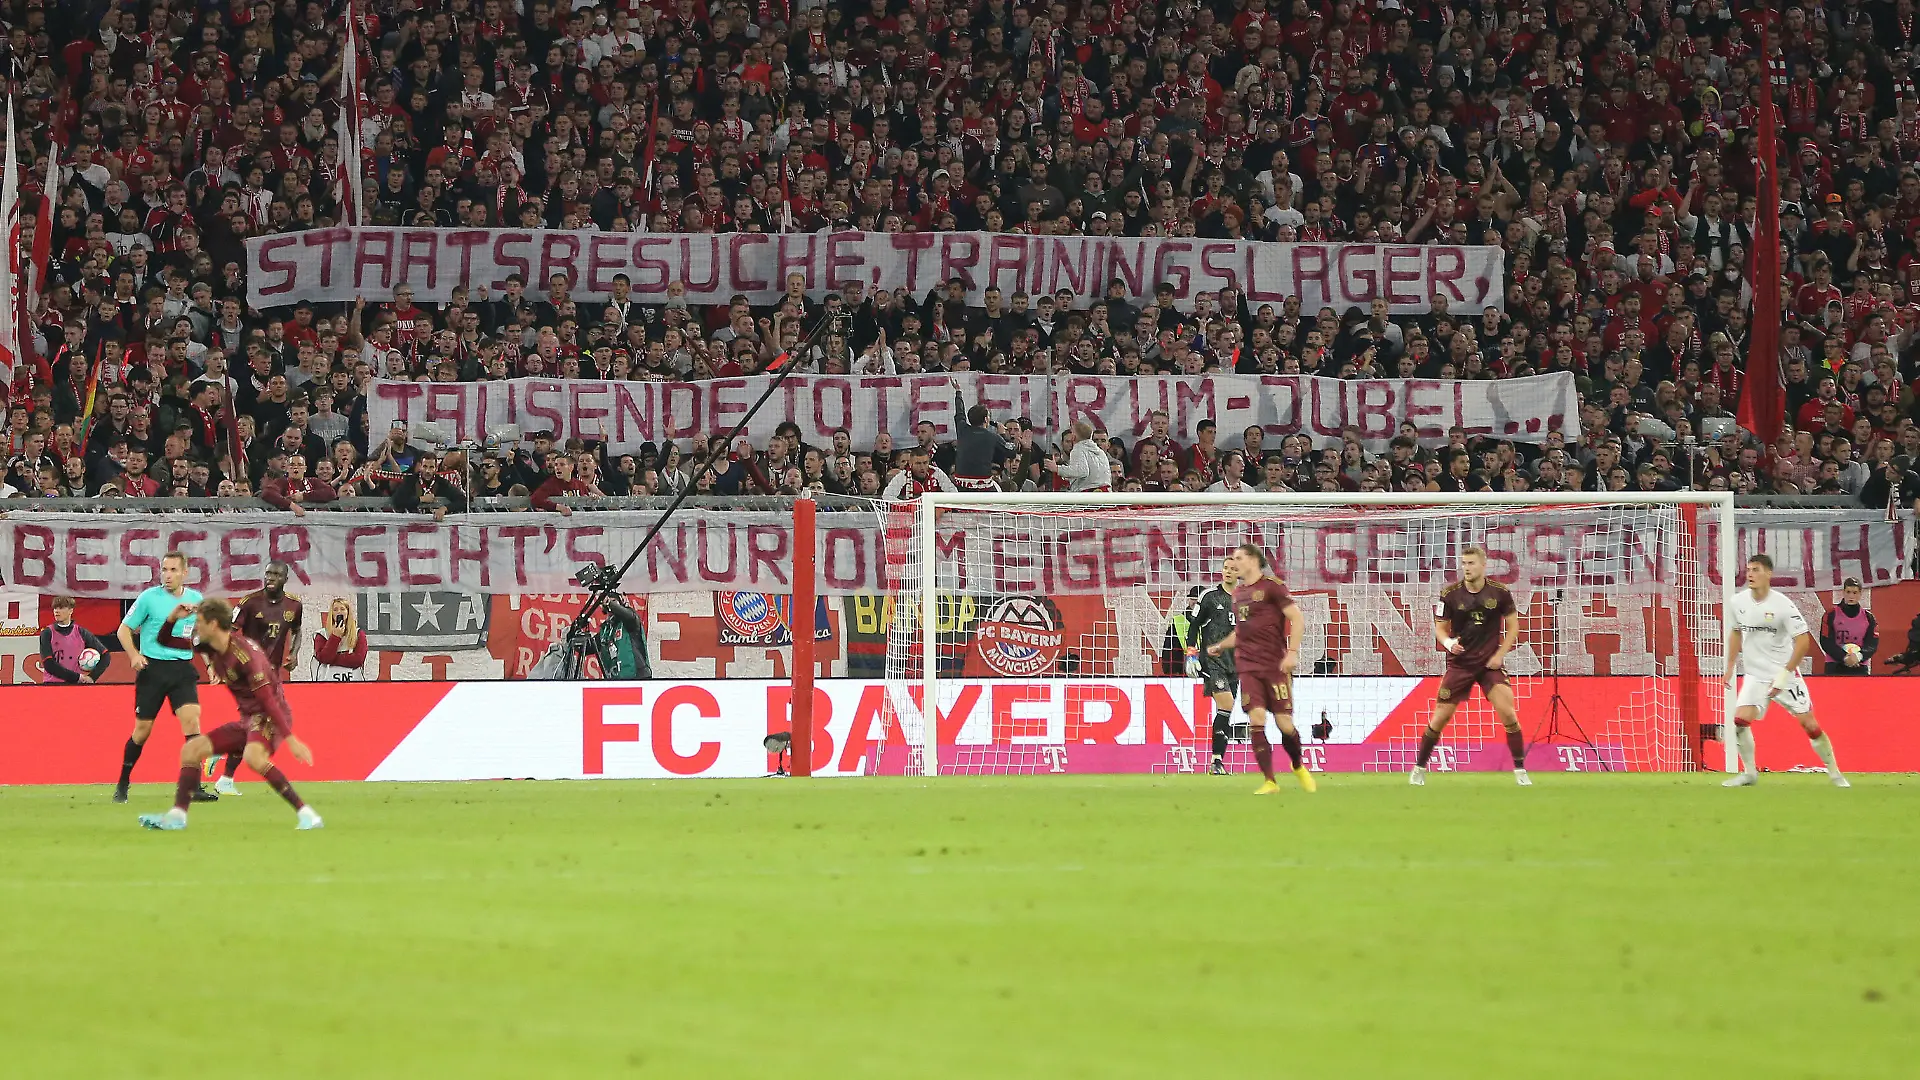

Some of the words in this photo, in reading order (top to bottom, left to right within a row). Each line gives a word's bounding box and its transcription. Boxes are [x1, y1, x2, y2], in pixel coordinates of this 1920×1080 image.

[258, 228, 881, 296] STAATSBESUCHE,
[891, 232, 1491, 305] TRAININGSLAGER,
[375, 380, 749, 443] TAUSENDE
[770, 376, 948, 438] TOTE
[13, 524, 312, 592] BESSER
[345, 523, 605, 588] GEHT'S
[646, 519, 788, 585] NUR
[992, 521, 1286, 593] EIGENEN
[977, 626, 996, 641] FC
[1000, 626, 1062, 647] BAYERN
[1272, 684, 1289, 701] 18
[1788, 684, 1806, 701] 14
[582, 685, 722, 775] FC
[767, 685, 1213, 774] BAYERN
